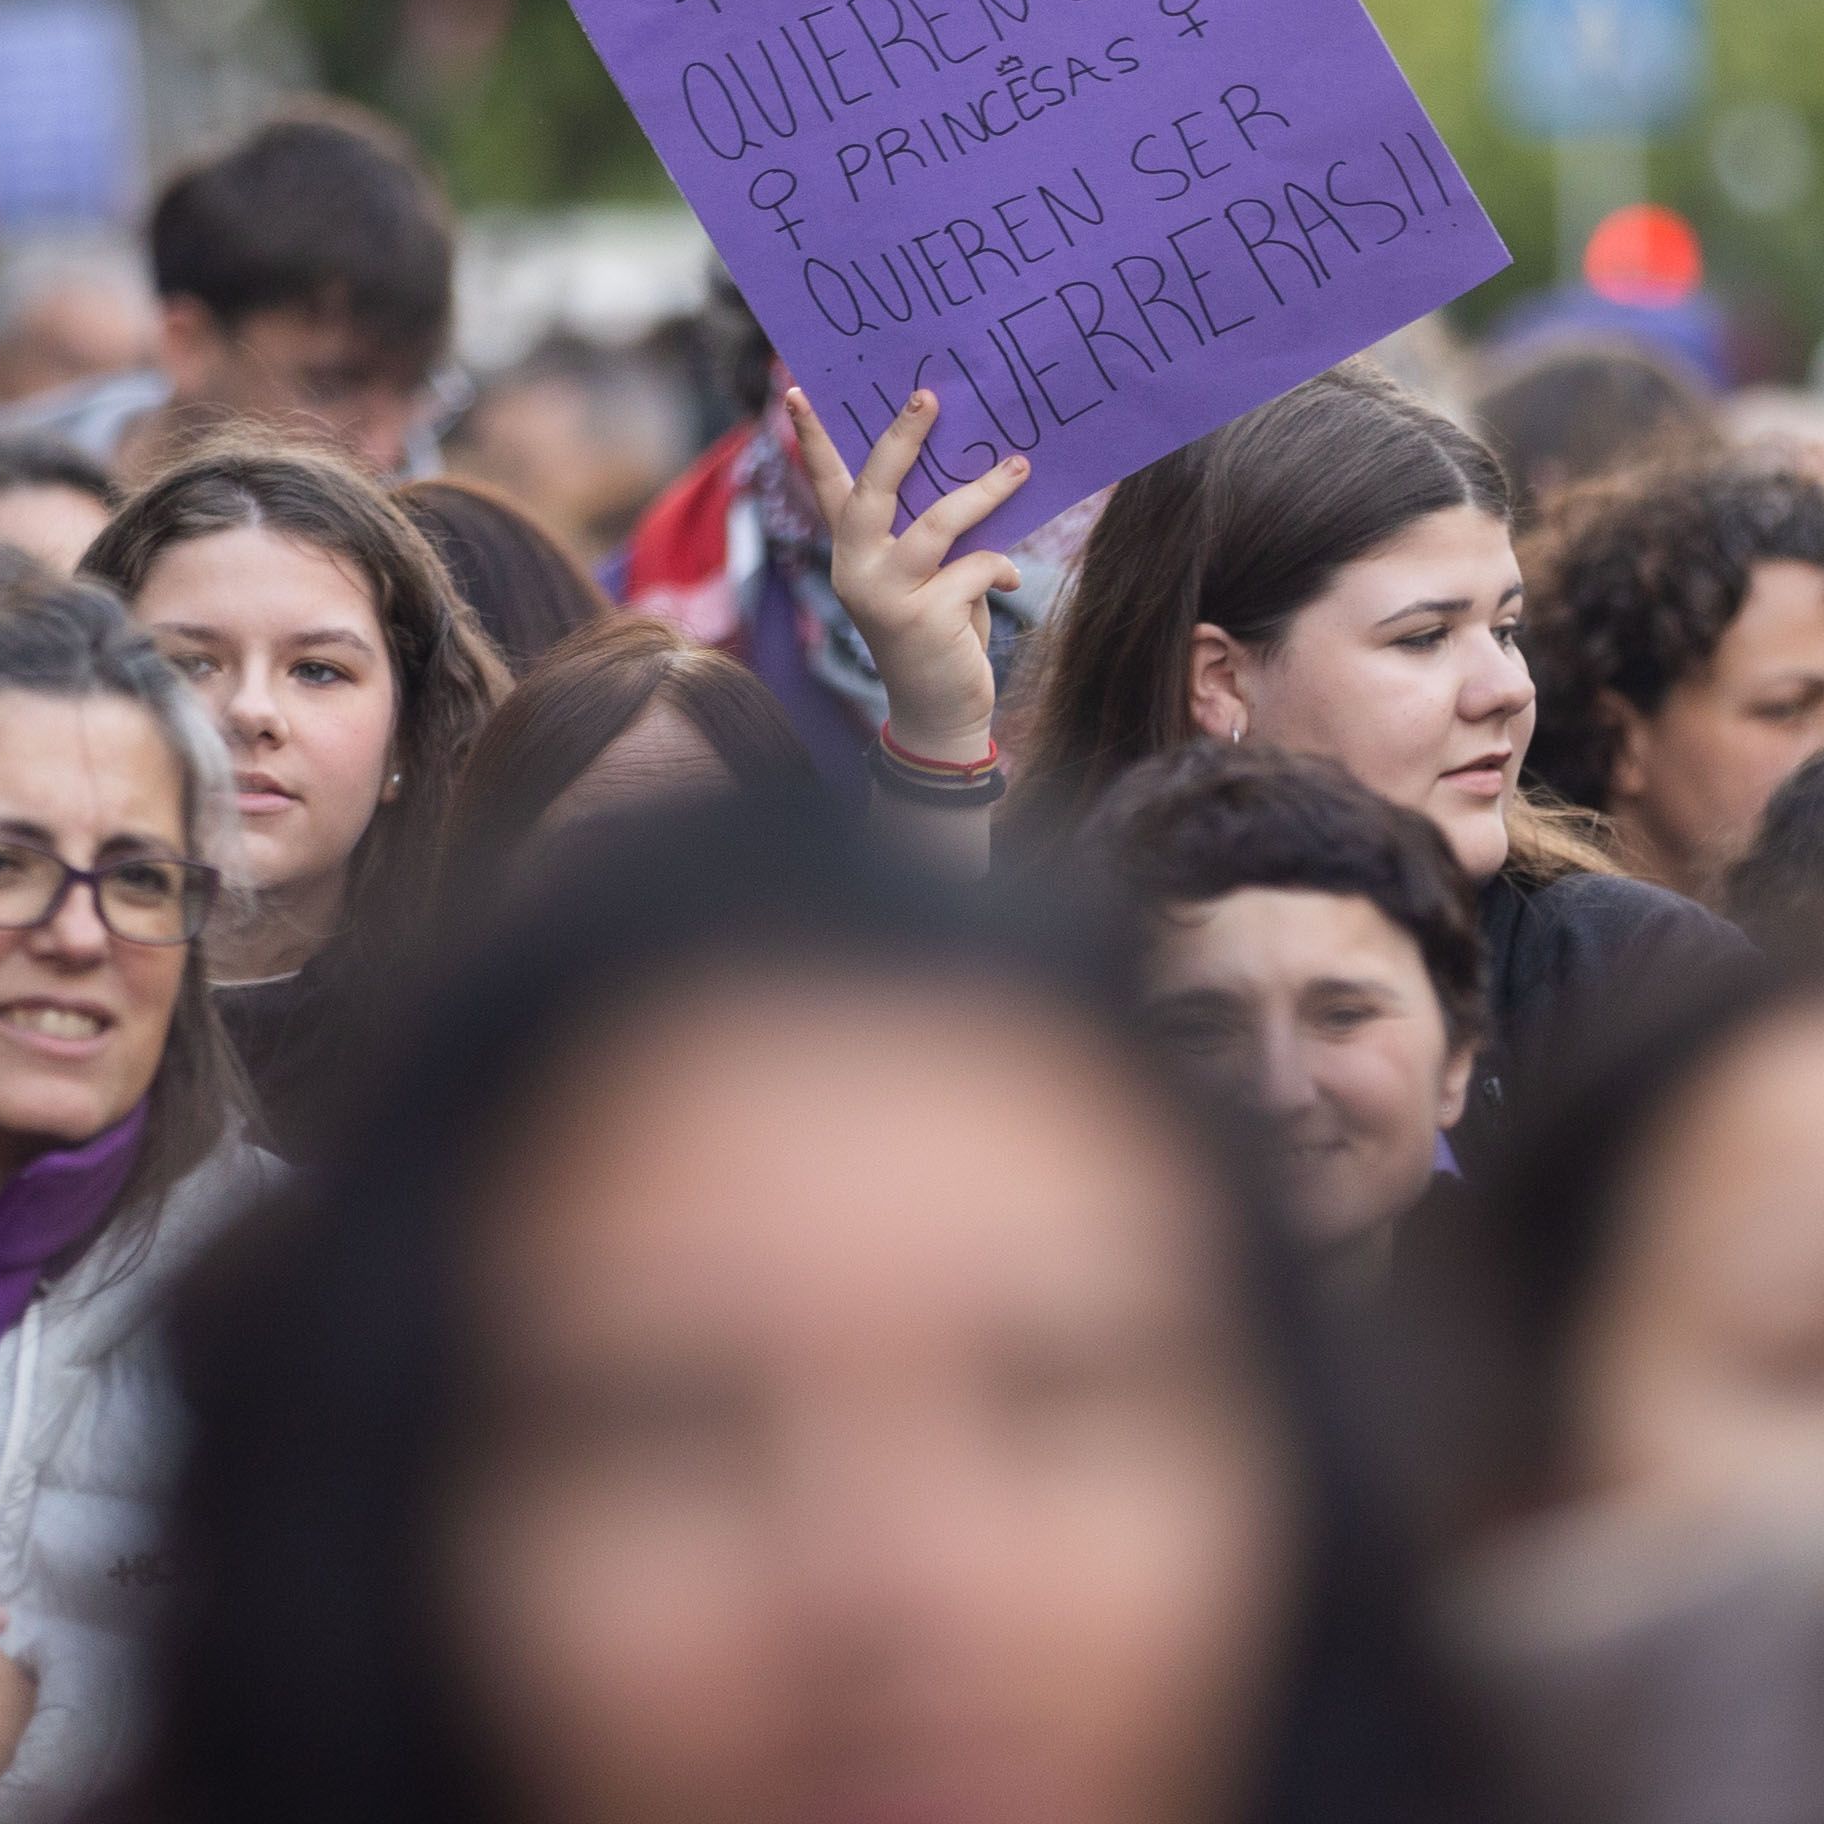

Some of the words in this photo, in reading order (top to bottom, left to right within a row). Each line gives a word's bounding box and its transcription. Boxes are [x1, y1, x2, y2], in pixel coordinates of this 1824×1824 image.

[803, 167, 1105, 337] QUIEREN
[1130, 84, 1291, 203] SER
[835, 36, 1140, 203] PRINCESAS
